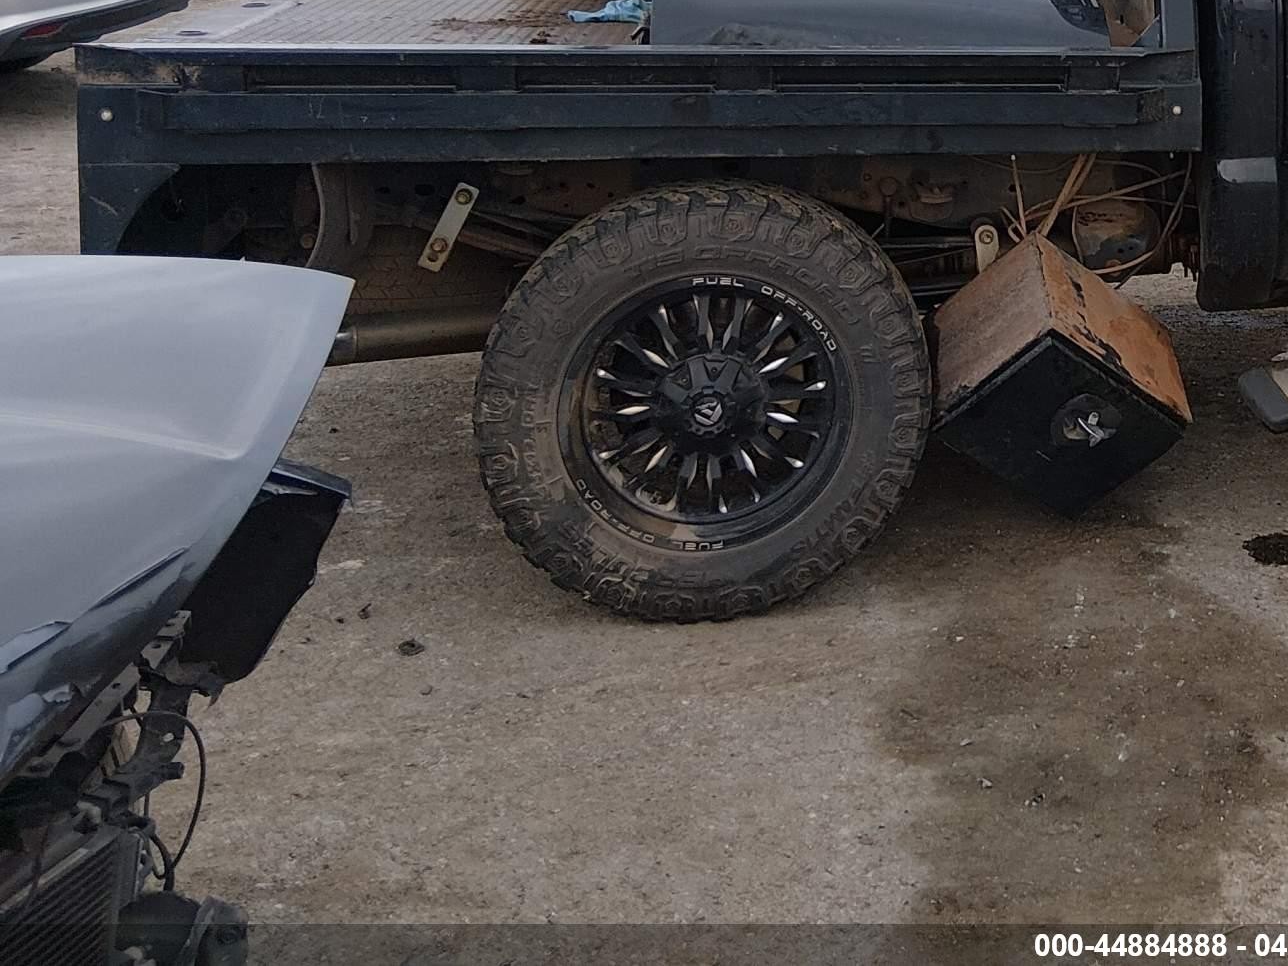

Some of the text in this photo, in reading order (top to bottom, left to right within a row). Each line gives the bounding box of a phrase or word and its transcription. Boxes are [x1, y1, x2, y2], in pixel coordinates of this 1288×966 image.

[692, 276, 838, 352] FUEL OFF-ROAD
[575, 478, 725, 552] FUEL OFF-ROAD
